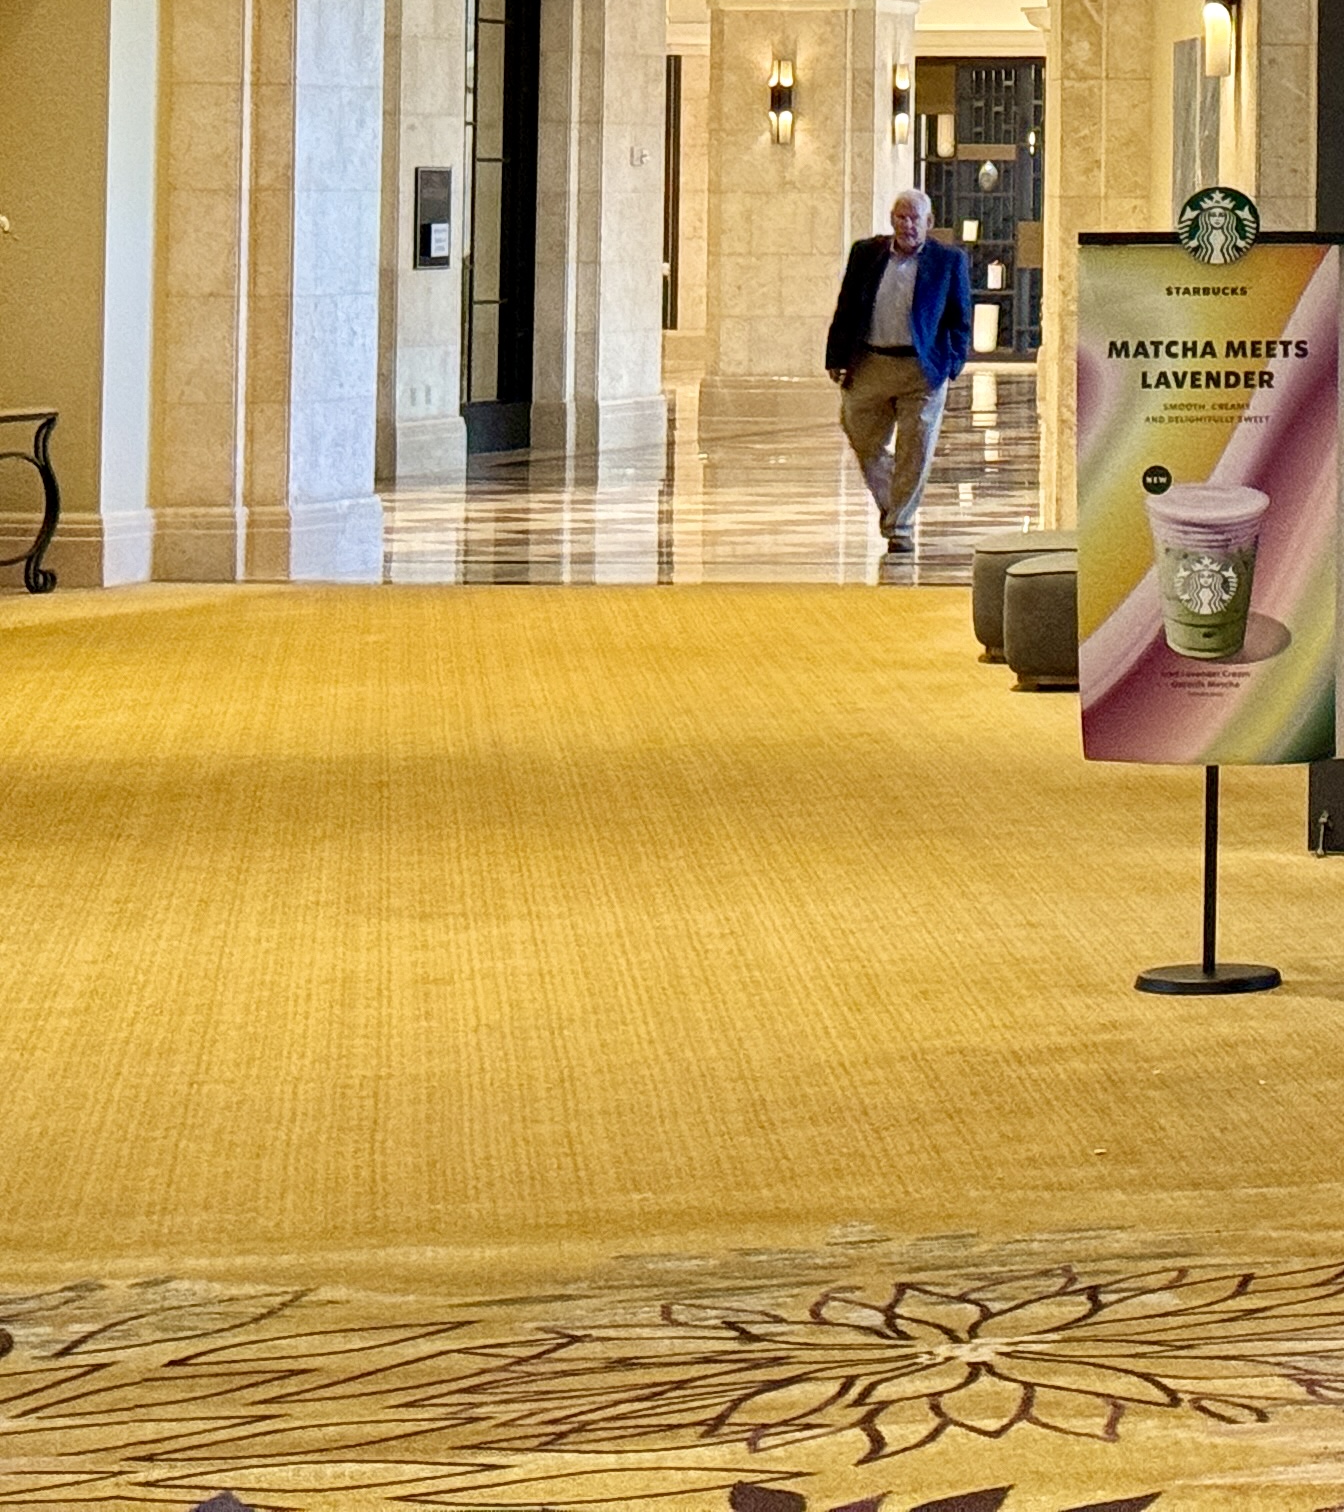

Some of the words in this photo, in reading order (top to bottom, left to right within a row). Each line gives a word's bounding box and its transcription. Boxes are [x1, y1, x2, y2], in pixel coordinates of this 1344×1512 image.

[1165, 285, 1248, 297] STARBUCKS
[1107, 339, 1217, 359] MATCHA
[1224, 339, 1309, 359] MEETS
[1140, 370, 1275, 389] LAVENDER
[1144, 414, 1166, 424] AND
[1236, 414, 1270, 424] SWEET
[1145, 475, 1168, 485] NEW
